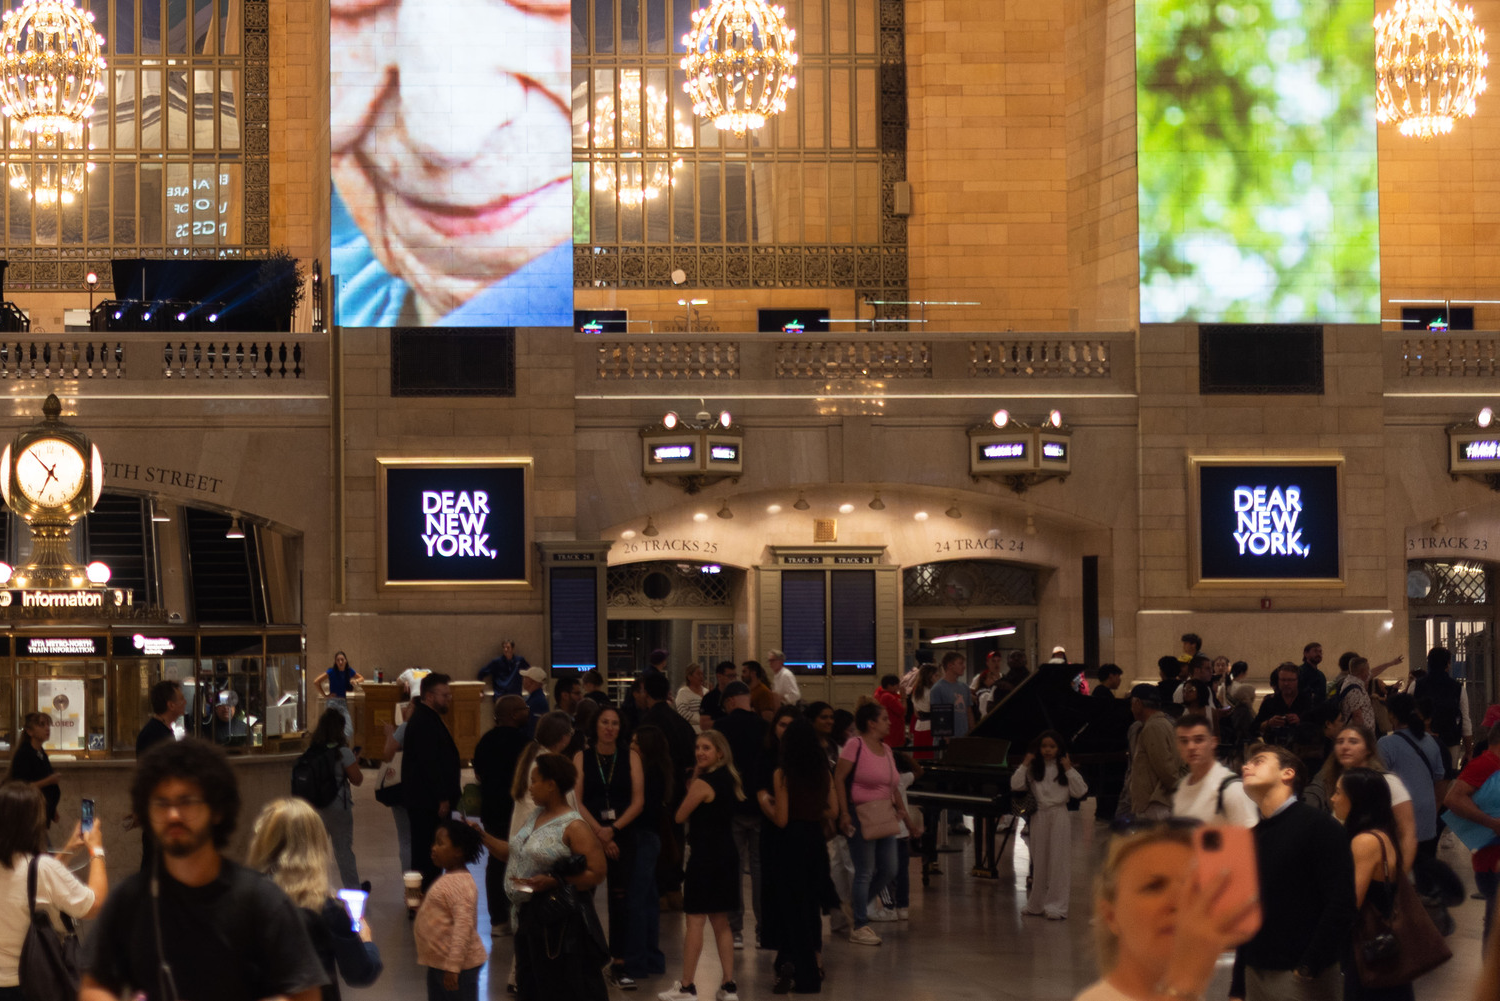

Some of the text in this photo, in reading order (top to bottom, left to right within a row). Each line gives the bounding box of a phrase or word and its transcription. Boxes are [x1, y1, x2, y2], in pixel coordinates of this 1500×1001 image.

[145, 466, 223, 493] STREET
[422, 490, 490, 514] DEAR
[1234, 486, 1302, 512] DEAR
[425, 513, 487, 536] NEW
[1237, 510, 1299, 533] NEW
[421, 534, 497, 559] YORK,
[624, 539, 718, 554] 26 TRACKS 25
[935, 538, 1024, 553] 24 TRACK 24
[1232, 530, 1310, 558] YORK,
[1418, 537, 1469, 549] TRACK
[1473, 539, 1488, 551] 23
[557, 553, 579, 561] TRACK
[22, 590, 102, 607] Information
[45, 638, 93, 647] METRO-NORTH
[51, 720, 75, 728] LOSED
